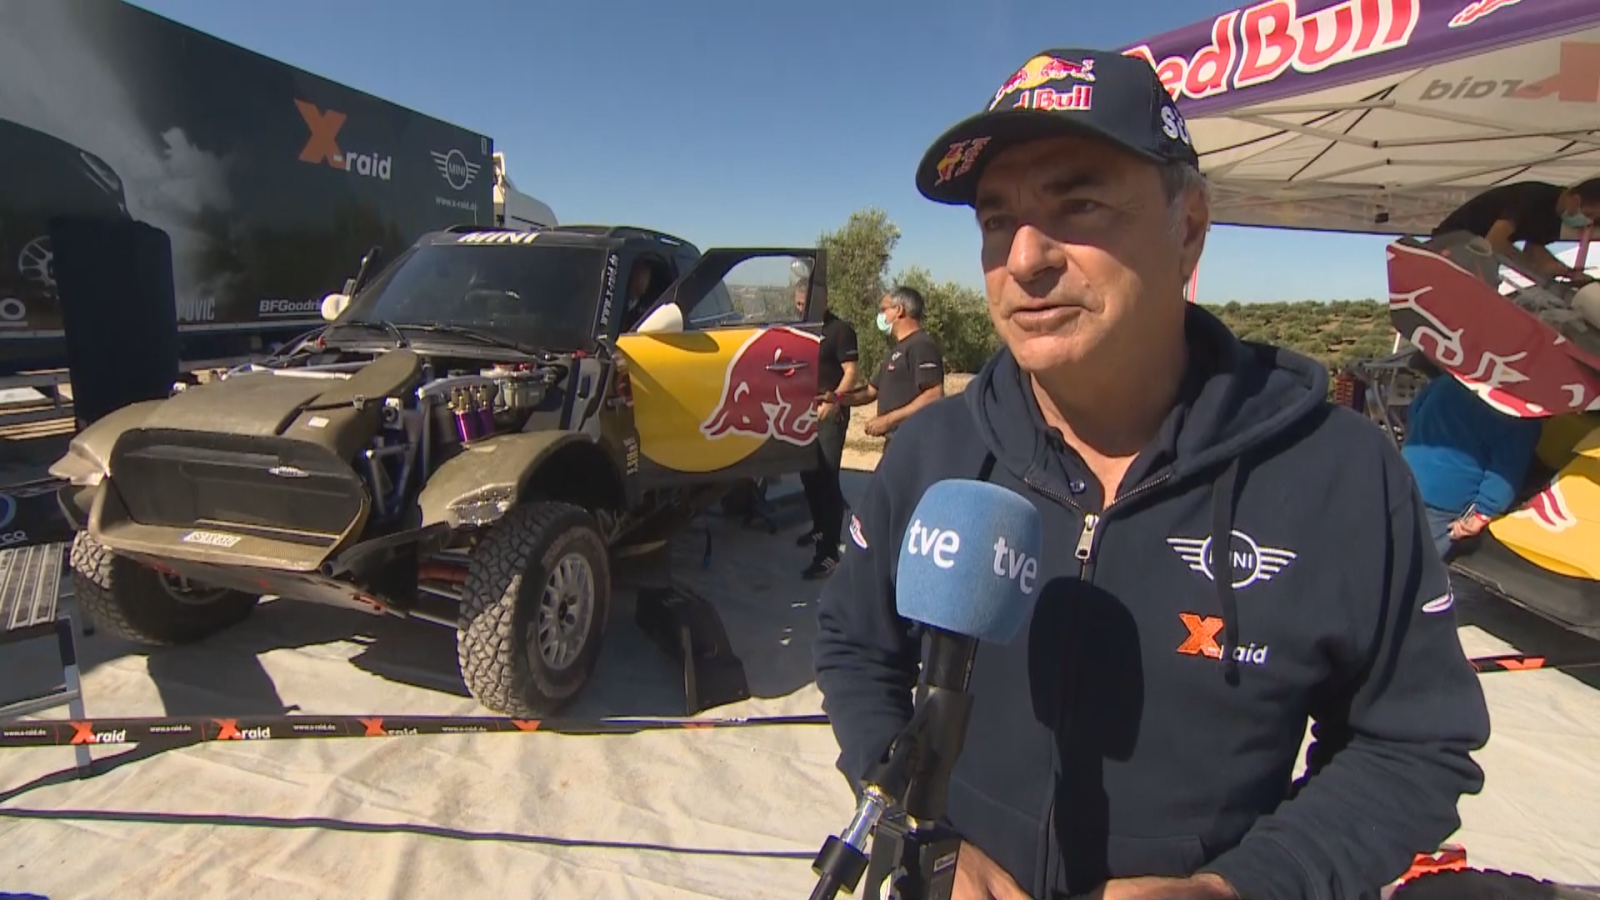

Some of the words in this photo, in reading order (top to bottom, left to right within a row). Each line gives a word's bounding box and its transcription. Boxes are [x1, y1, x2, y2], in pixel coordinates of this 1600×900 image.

[1121, 10, 1239, 100] ed
[1233, 0, 1419, 88] Bull
[1034, 85, 1092, 111] Bull
[293, 97, 392, 181] X-raid
[448, 163, 466, 177] MINI
[259, 298, 321, 314] BFGoodri
[908, 518, 960, 570] tve
[993, 536, 1037, 595] tve
[69, 721, 126, 744] X-raid
[211, 718, 271, 741] X-raid
